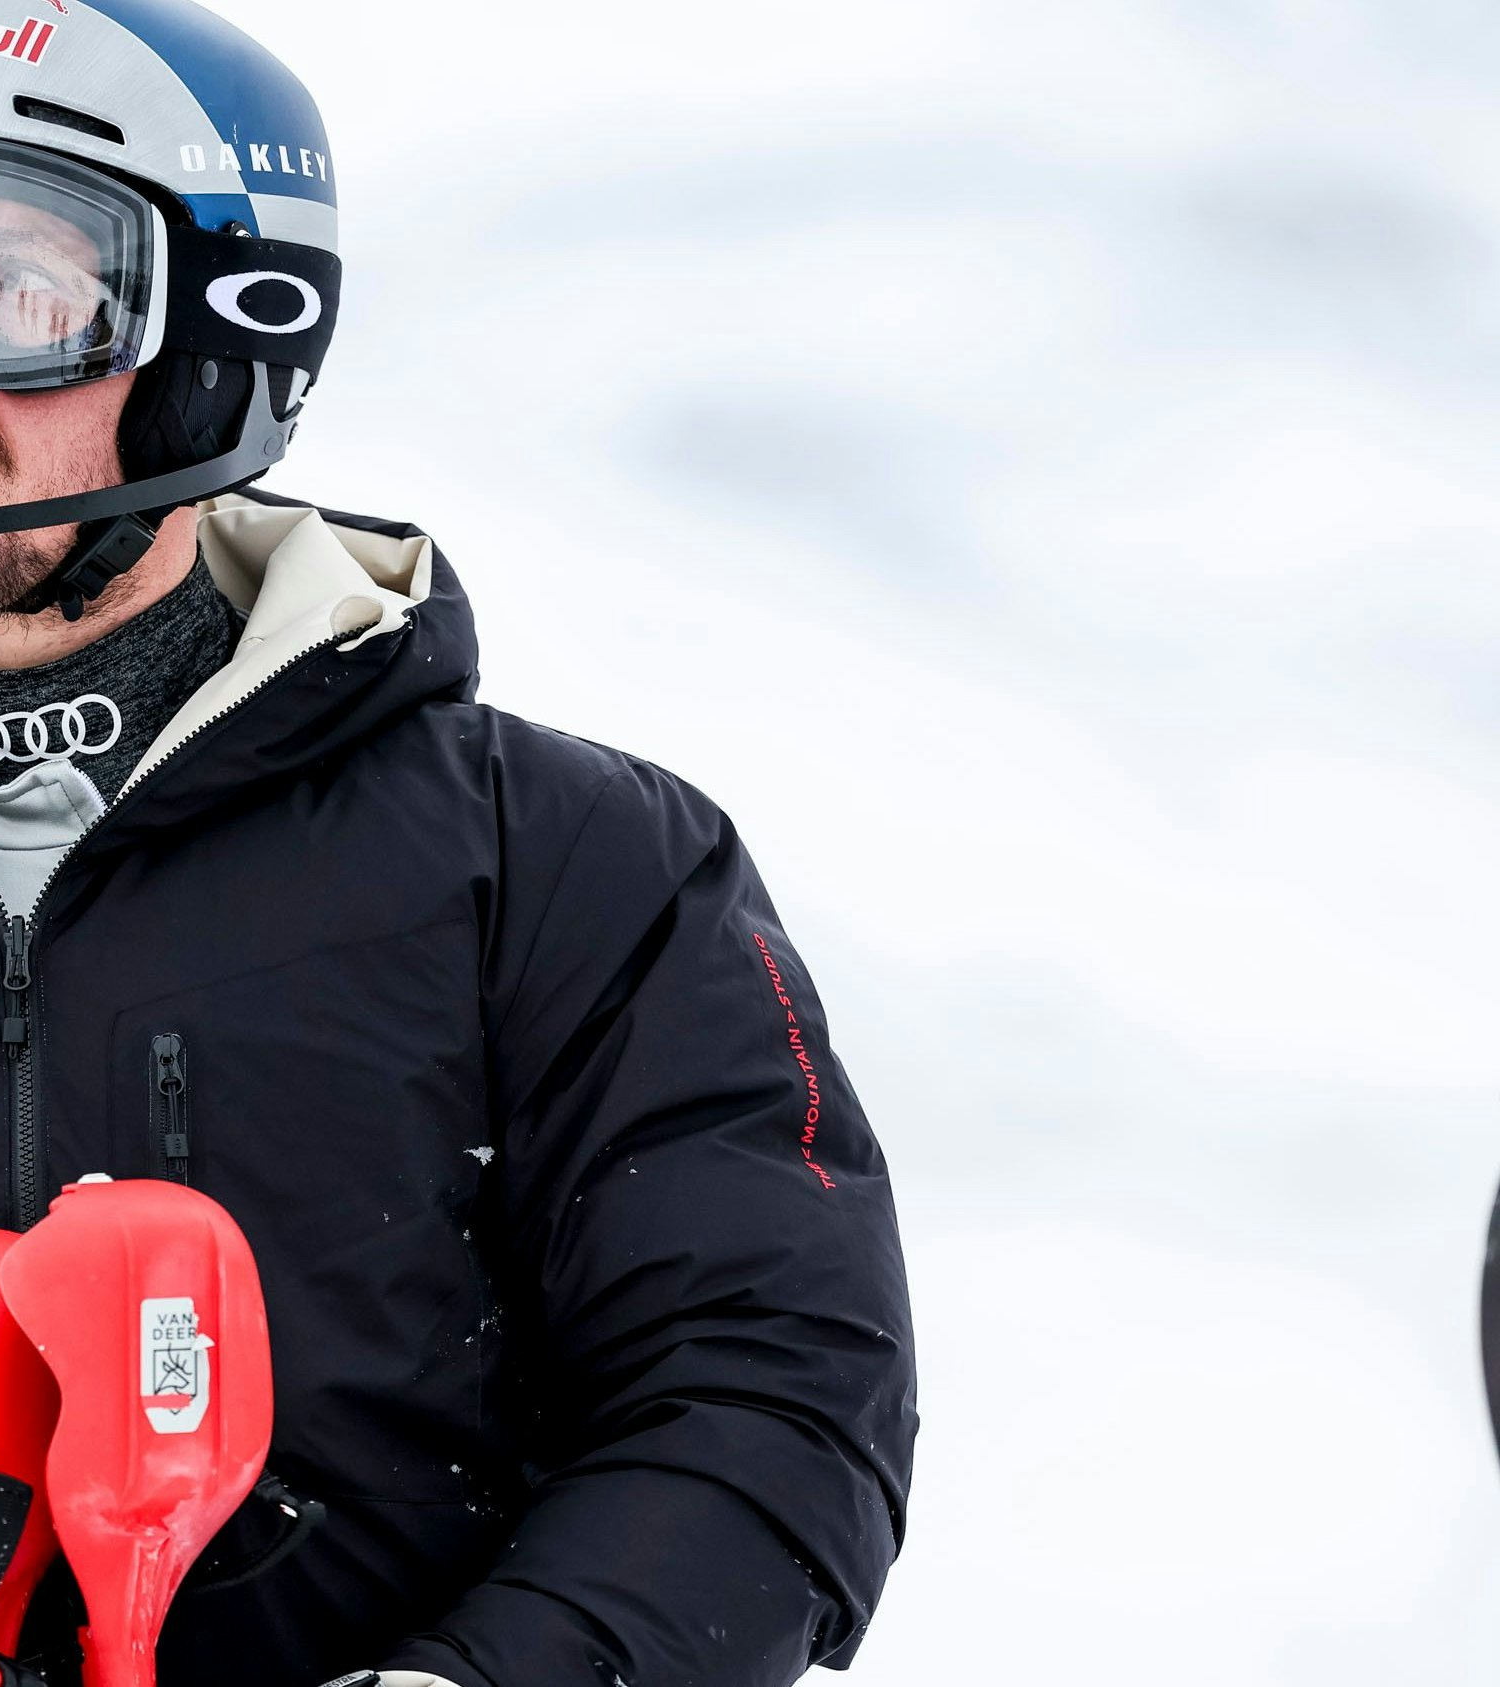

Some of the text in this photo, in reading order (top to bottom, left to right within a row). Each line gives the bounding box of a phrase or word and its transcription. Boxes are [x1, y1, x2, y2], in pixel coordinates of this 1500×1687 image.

[180, 143, 326, 182] OAKLEY
[752, 933, 792, 1007] STUDIO
[788, 1028, 821, 1145] MOUNTAIN
[805, 1161, 837, 1190] THE
[153, 1327, 197, 1341] DEER
[158, 1313, 193, 1325] VAN
